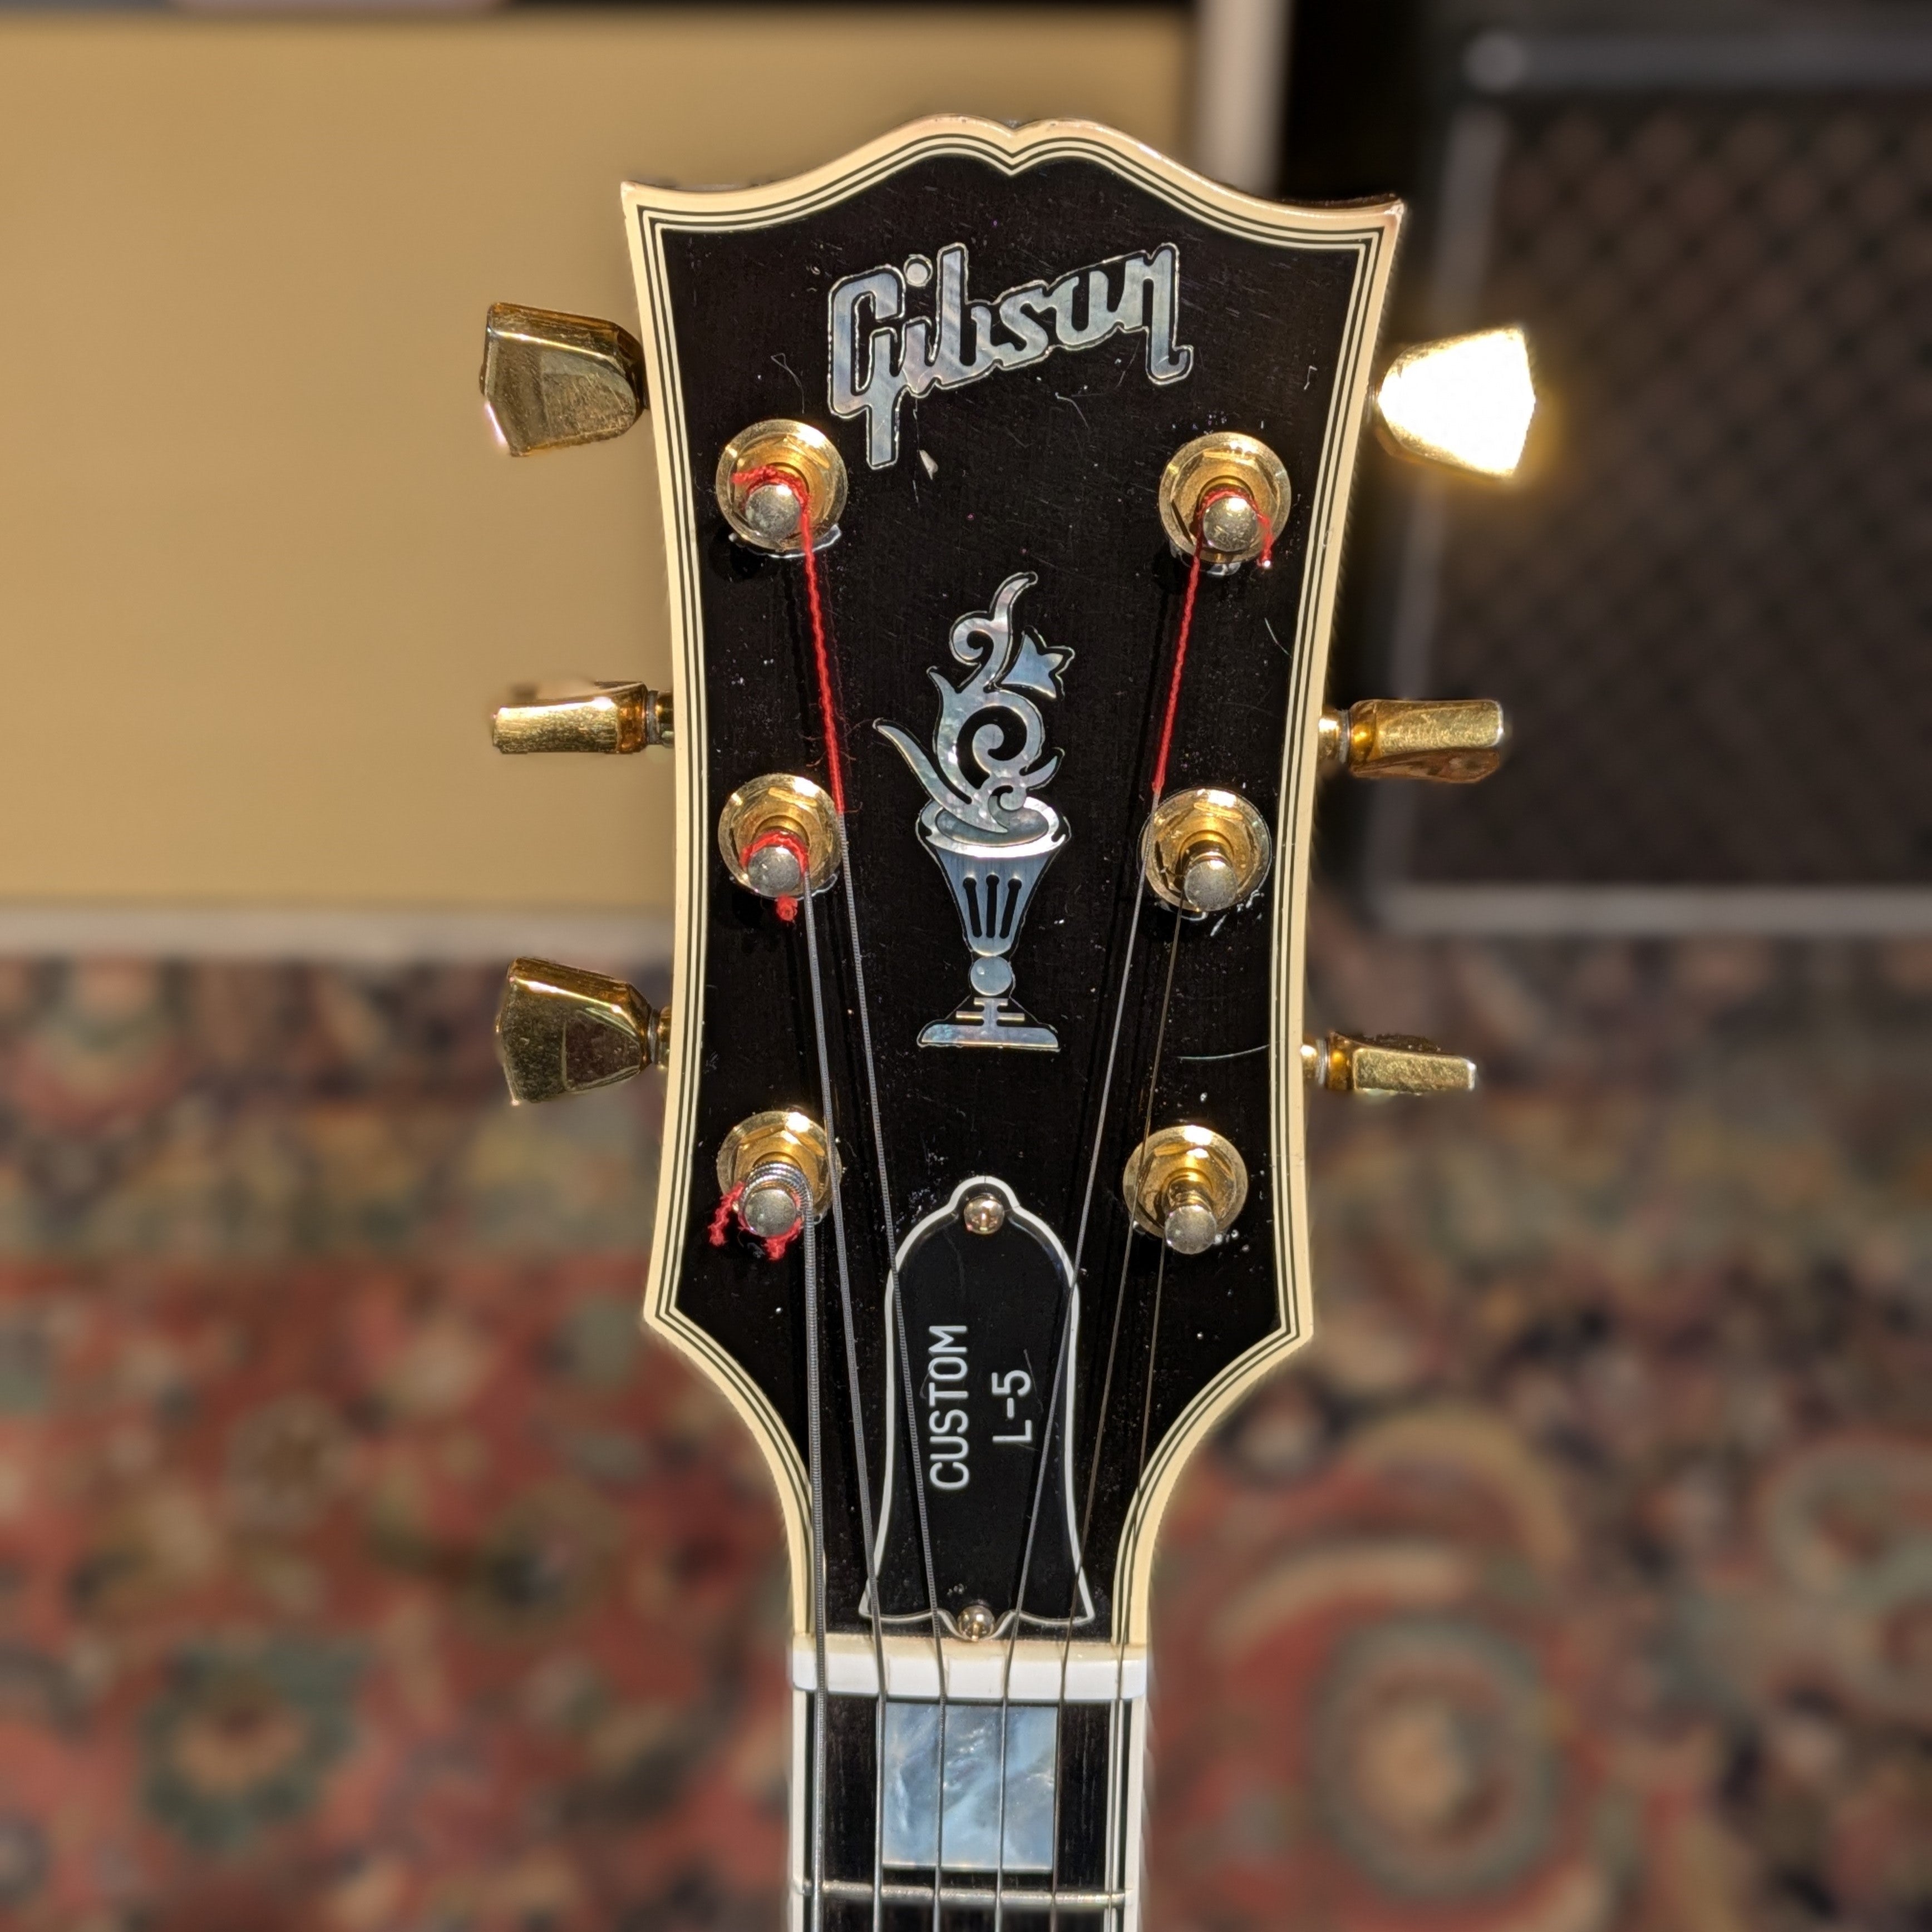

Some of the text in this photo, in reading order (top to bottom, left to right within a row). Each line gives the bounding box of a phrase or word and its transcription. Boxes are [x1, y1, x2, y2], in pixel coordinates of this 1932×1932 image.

[829, 243, 1194, 469] Gibson
[928, 1325, 969, 1490] CUSTOM
[991, 1369, 1032, 1443] L-5
